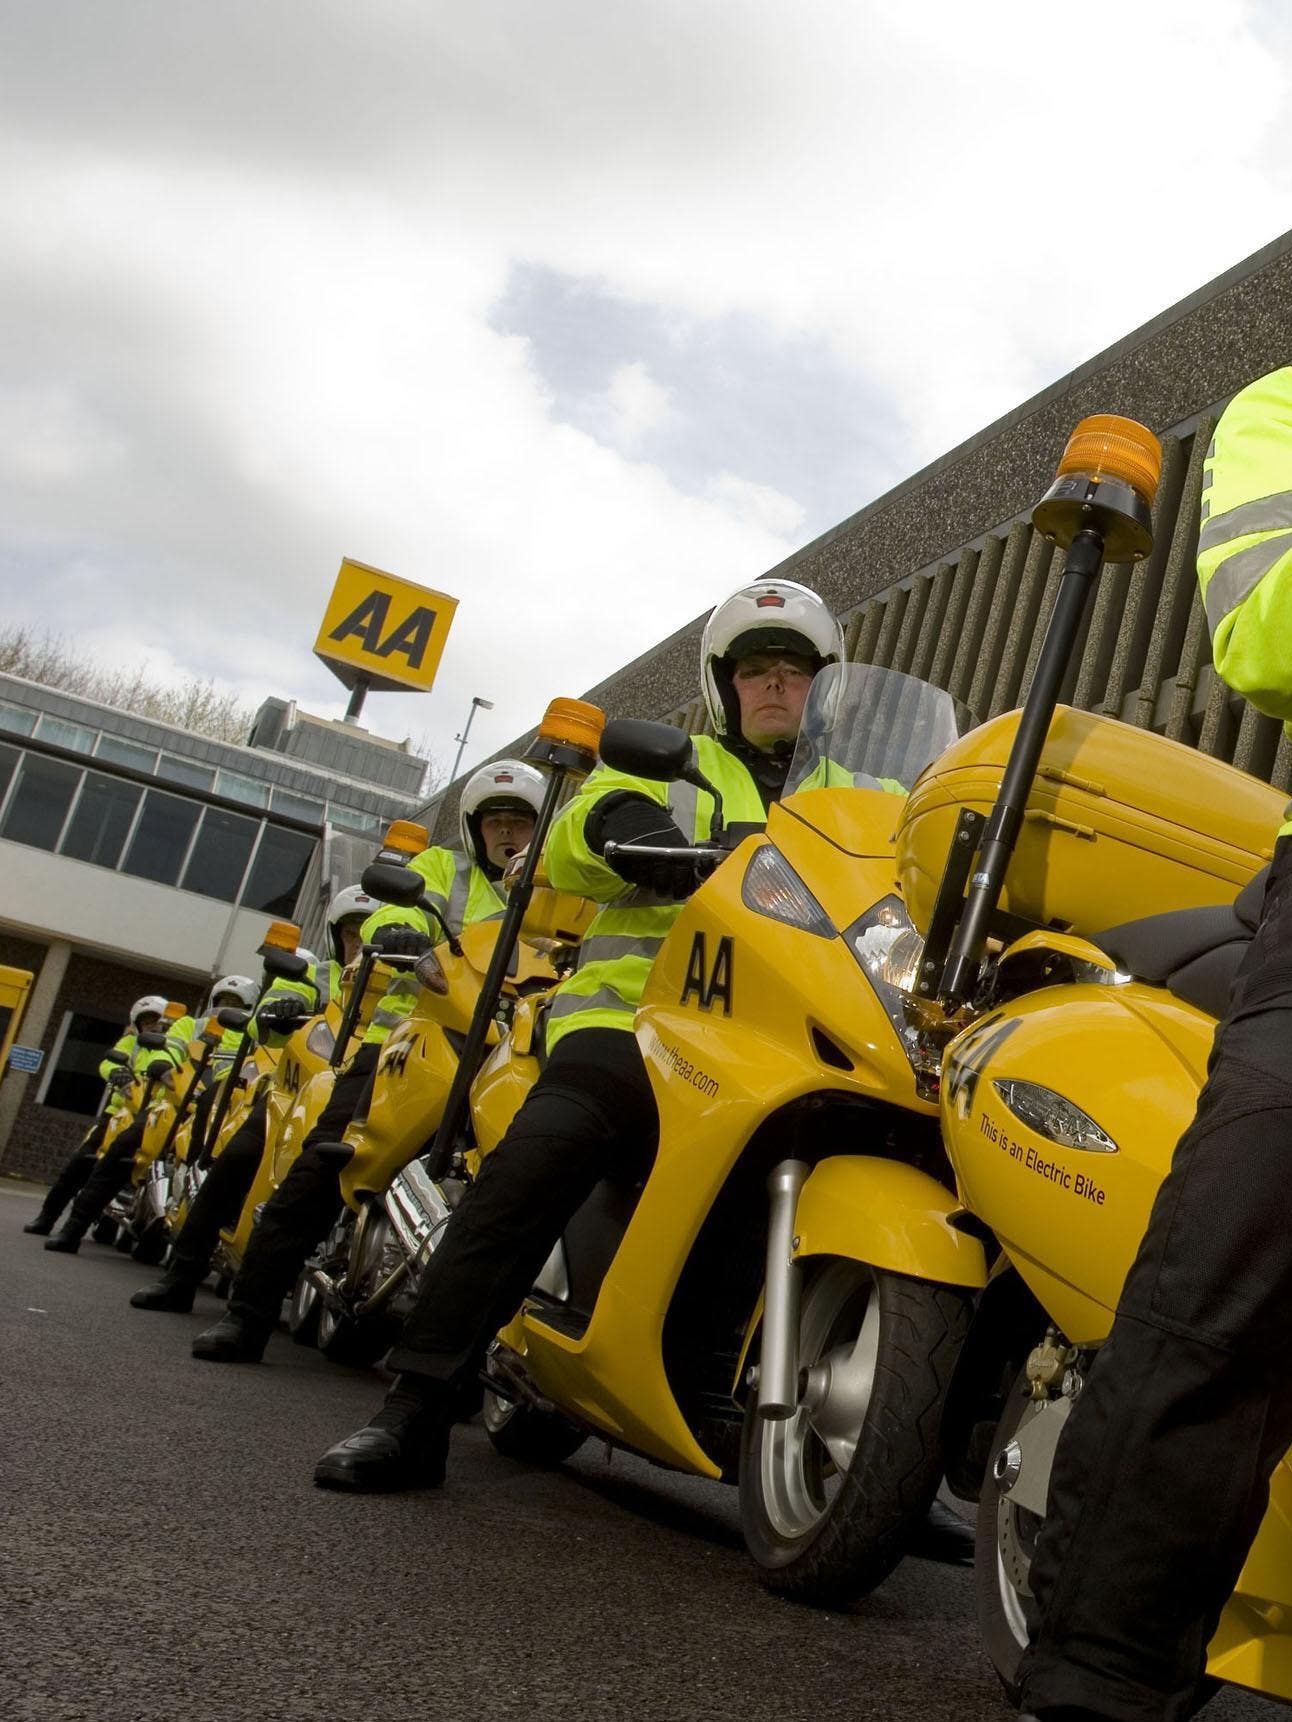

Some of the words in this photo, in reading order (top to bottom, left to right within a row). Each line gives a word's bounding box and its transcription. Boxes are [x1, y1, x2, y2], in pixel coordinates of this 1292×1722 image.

[329, 590, 436, 669] AA
[679, 930, 735, 1017] AA
[980, 1113, 998, 1143] This
[999, 1128, 1009, 1151] is
[1009, 1142, 1024, 1162] an
[1025, 1147, 1071, 1189] Electric
[1074, 1174, 1105, 1205] Bike
